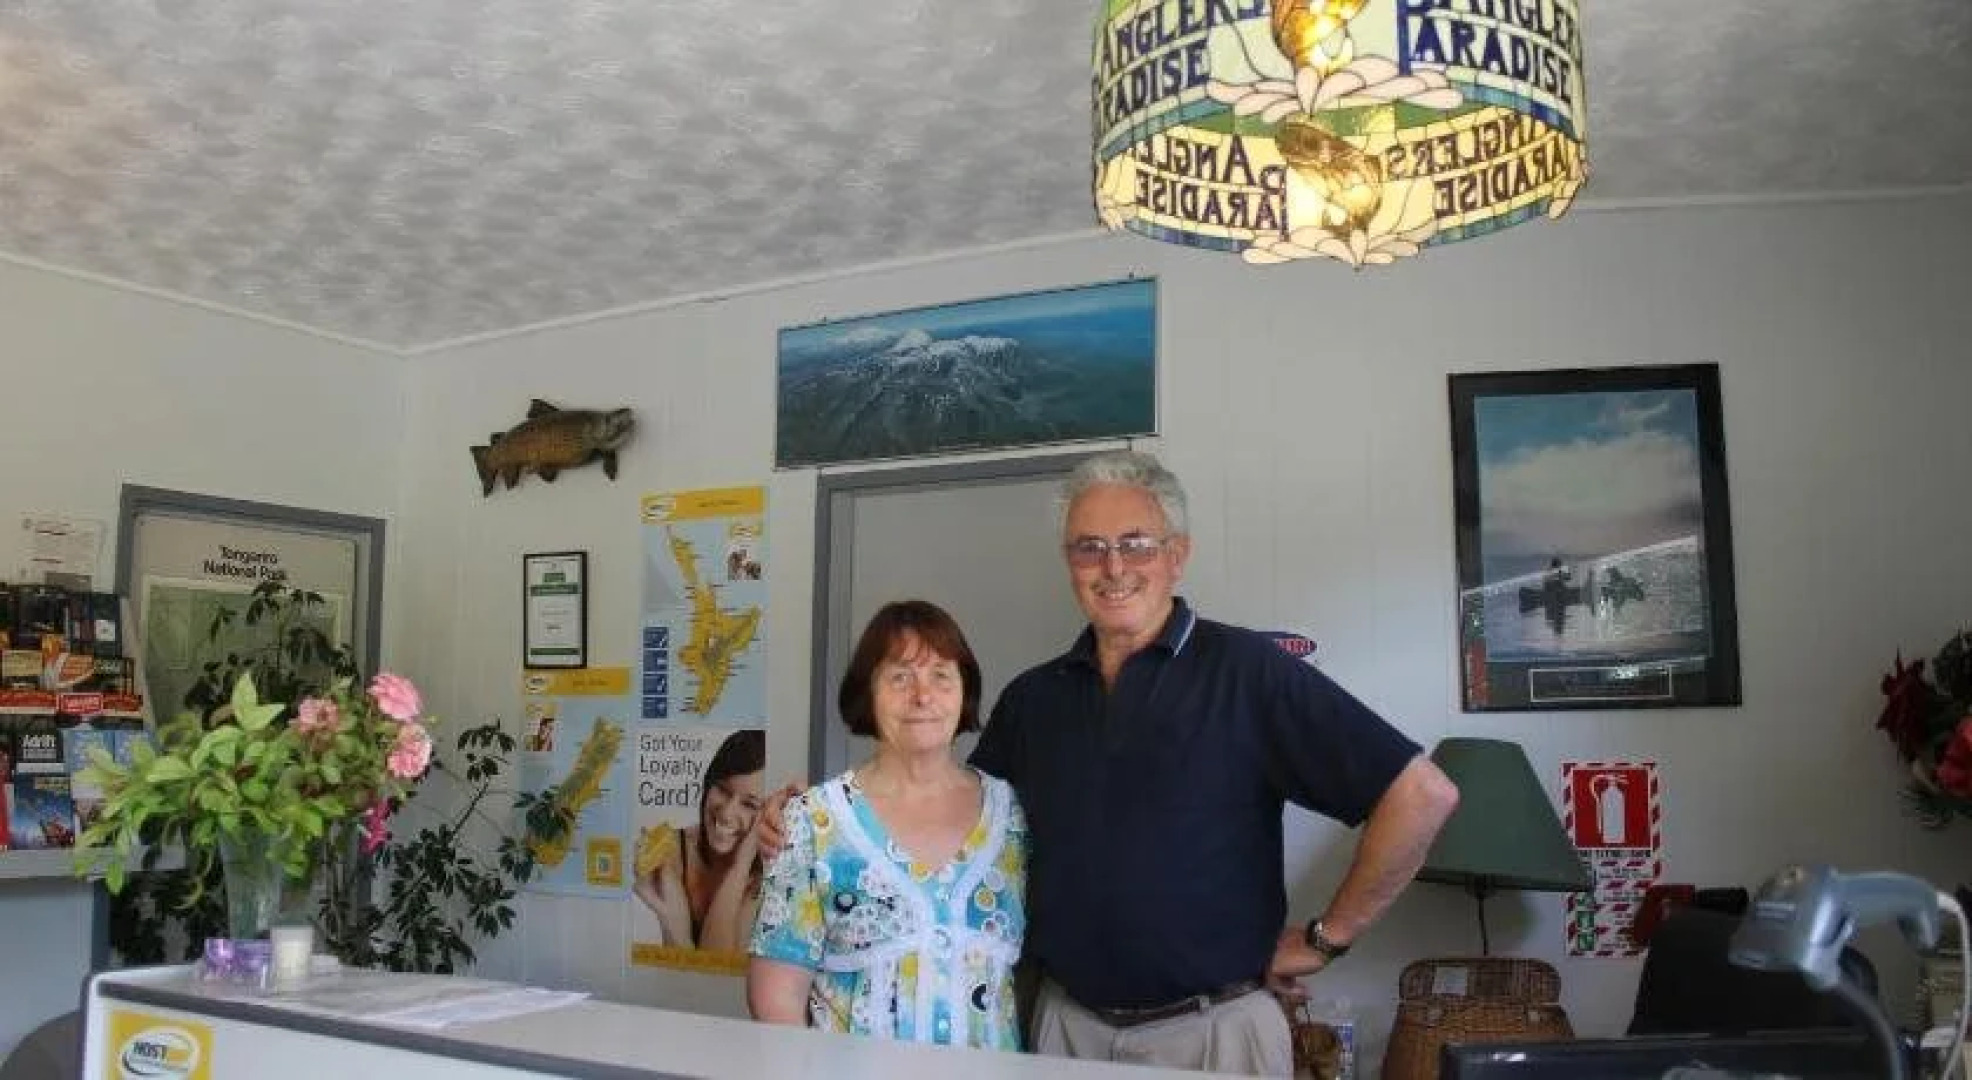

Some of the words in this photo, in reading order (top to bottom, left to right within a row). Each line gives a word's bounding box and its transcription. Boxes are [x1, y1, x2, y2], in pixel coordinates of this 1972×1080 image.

[640, 734, 666, 752] Got
[668, 734, 703, 752] Your
[640, 754, 703, 780] Loyalty
[638, 781, 701, 807] Card?
